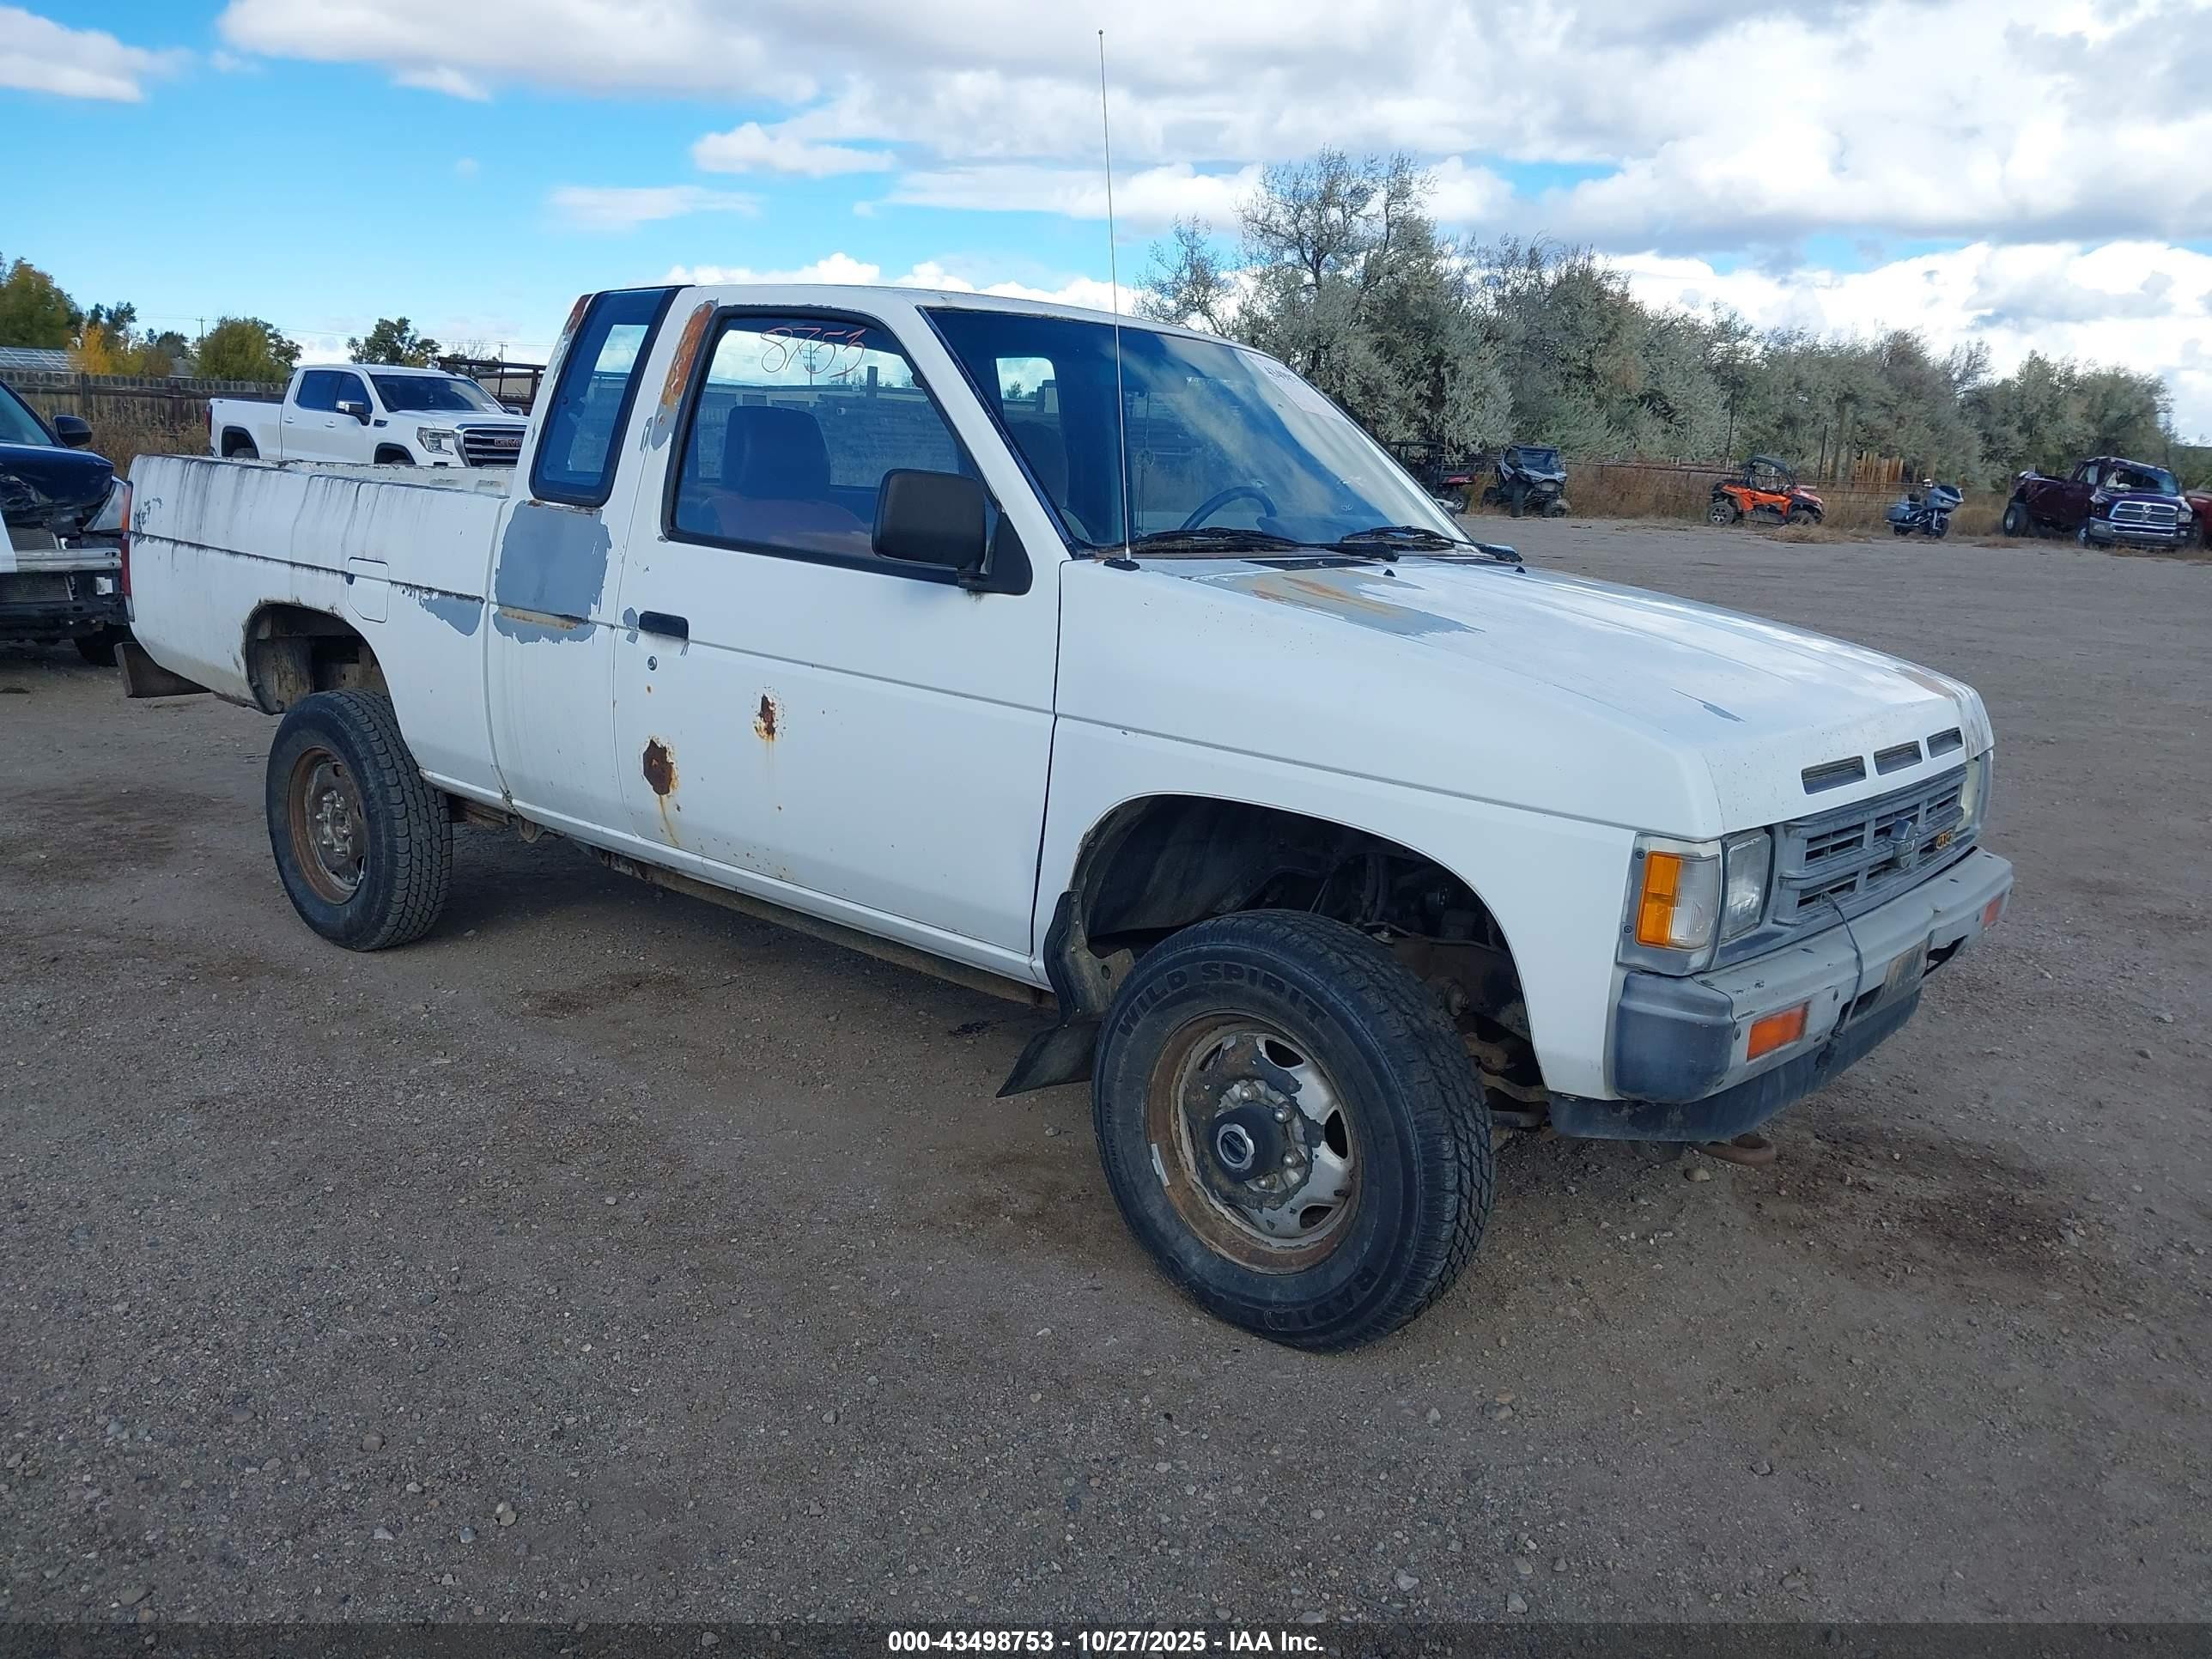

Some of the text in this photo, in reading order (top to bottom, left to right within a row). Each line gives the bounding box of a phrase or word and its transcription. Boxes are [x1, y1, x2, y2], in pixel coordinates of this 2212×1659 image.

[759, 326, 867, 379] 8753
[1117, 961, 1330, 1038] WILD SPIRIT
